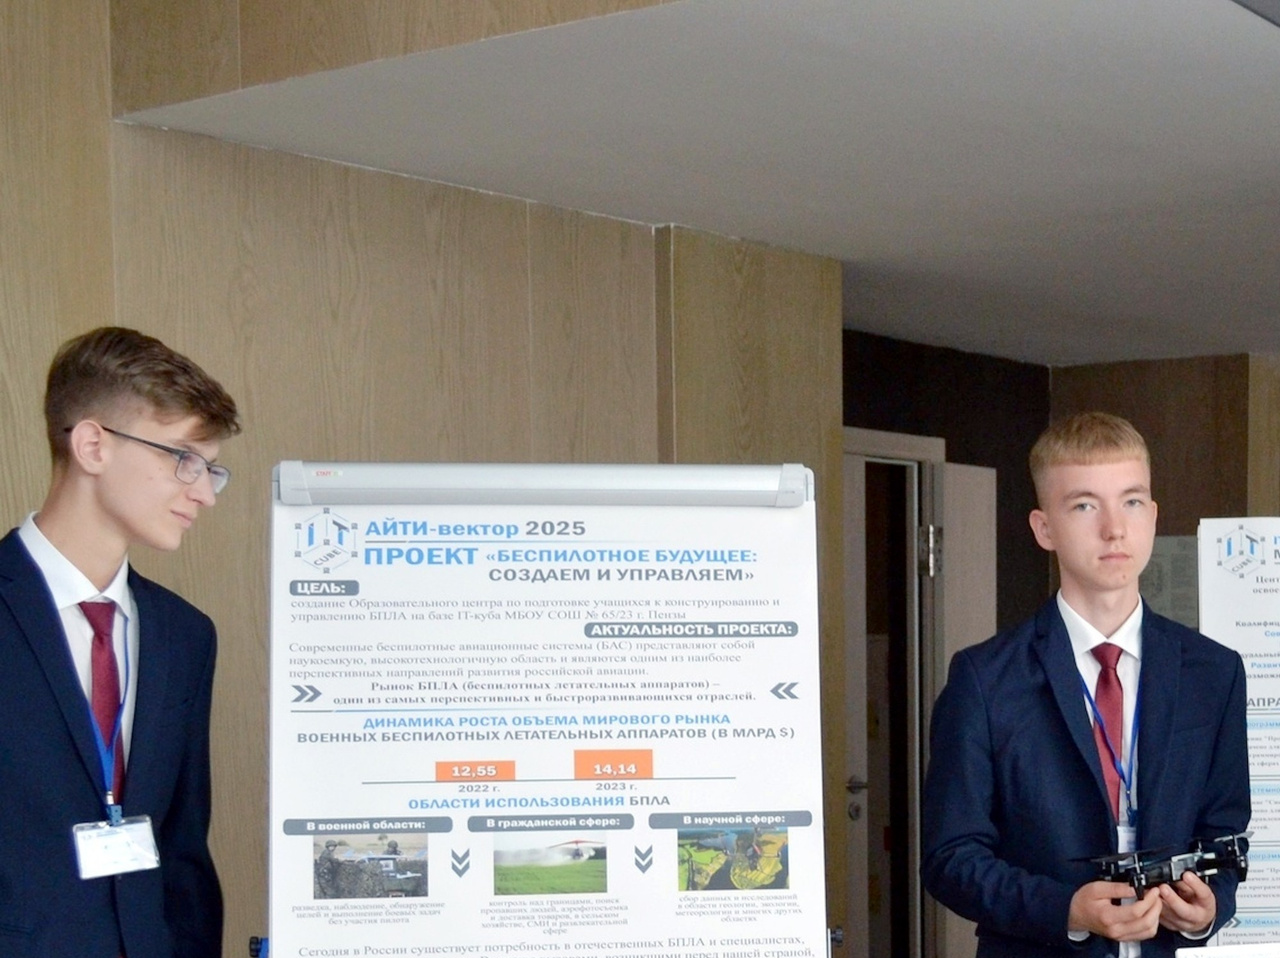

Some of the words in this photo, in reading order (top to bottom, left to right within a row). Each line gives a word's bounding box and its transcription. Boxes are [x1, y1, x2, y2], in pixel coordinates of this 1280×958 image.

[365, 517, 519, 538] АЙТИ-вектор
[525, 520, 585, 536] 2025
[313, 549, 342, 566] CUBE
[364, 548, 478, 565] ПРОЕКТ
[486, 548, 649, 562] «БЕСПИЛОТНОЕ
[655, 549, 756, 564] БУДУЩЕЕ:
[1231, 558, 1252, 573] CUBE
[488, 568, 590, 583] СОЗДАЕМ
[597, 568, 610, 580] И
[616, 568, 753, 581] УПРАВЛЯЕМ»
[297, 582, 345, 595] ЦЕЛЬ:
[290, 600, 345, 608] создание
[348, 598, 458, 609] Образовательного
[461, 599, 502, 609] центра
[506, 599, 521, 607] по
[524, 599, 590, 607] подготовке
[593, 599, 650, 608] учащихся
[664, 599, 769, 608] конструированию
[290, 613, 365, 623] управлению
[369, 610, 406, 620] БПЛА
[427, 610, 453, 620] базе
[457, 610, 501, 622] IT-куба
[504, 610, 543, 620] МБОУ
[547, 609, 581, 619] СОШ
[584, 610, 598, 619] №
[601, 609, 632, 619] 65/23
[648, 609, 686, 619] Пензы
[590, 623, 714, 635] АКТУАЛЬНОСТЬ
[717, 623, 792, 635] ПРОЕКТА:
[288, 642, 373, 654] Современные
[376, 641, 455, 651] беспилотные
[458, 643, 539, 651] авиационные
[635, 642, 716, 651] представляют
[720, 639, 755, 649] собой
[289, 657, 367, 667] наукоемкую,
[370, 656, 507, 666] высокотехнологичную
[510, 653, 556, 663] область
[571, 655, 626, 663] являются
[629, 655, 667, 663] одним
[687, 652, 741, 662] наиболее
[288, 670, 382, 679] перспективных
[386, 667, 463, 679] направлений
[467, 669, 520, 678] развития
[524, 666, 593, 678] российской
[596, 668, 648, 676] авиации.
[371, 681, 413, 691] Рынок
[418, 681, 458, 690] БПЛА
[462, 680, 550, 691] (беспилотных
[640, 679, 710, 690] аппаратов)
[430, 695, 529, 705] перспективных
[545, 692, 692, 704] быстроразвивающихся
[696, 691, 755, 703] отраслей.
[363, 716, 454, 729] ДИНАМИКА
[458, 716, 508, 726] РОСТА
[511, 715, 578, 726] ОБЪЕМА
[582, 714, 670, 725] МИРОВОГО
[674, 713, 730, 724] РЫНКА
[297, 732, 376, 743] ВОЕННЫХ
[381, 730, 500, 741] БЕСПИЛОТНЫХ
[503, 729, 612, 740] ЛЕТАТЕЛЬНЫХ
[616, 728, 706, 739] АППАРАТОВ
[732, 727, 776, 739] МЛРД
[452, 765, 497, 778] 12,55
[594, 764, 637, 775] 14,14
[458, 784, 489, 792] 2022
[595, 782, 626, 790] 2023
[408, 798, 480, 809] ОБЛАСТИ
[484, 795, 624, 808] ИСПОЛЬЗОВАНИЯ
[629, 795, 670, 806] БПЛА
[306, 821, 315, 830] В
[317, 820, 370, 830] военной
[372, 819, 425, 829] области:
[486, 818, 495, 827] В
[497, 817, 576, 829] гражданской
[578, 817, 620, 827] сфере:
[683, 815, 692, 824] В
[694, 814, 743, 825] научной
[744, 814, 785, 824] сфере:
